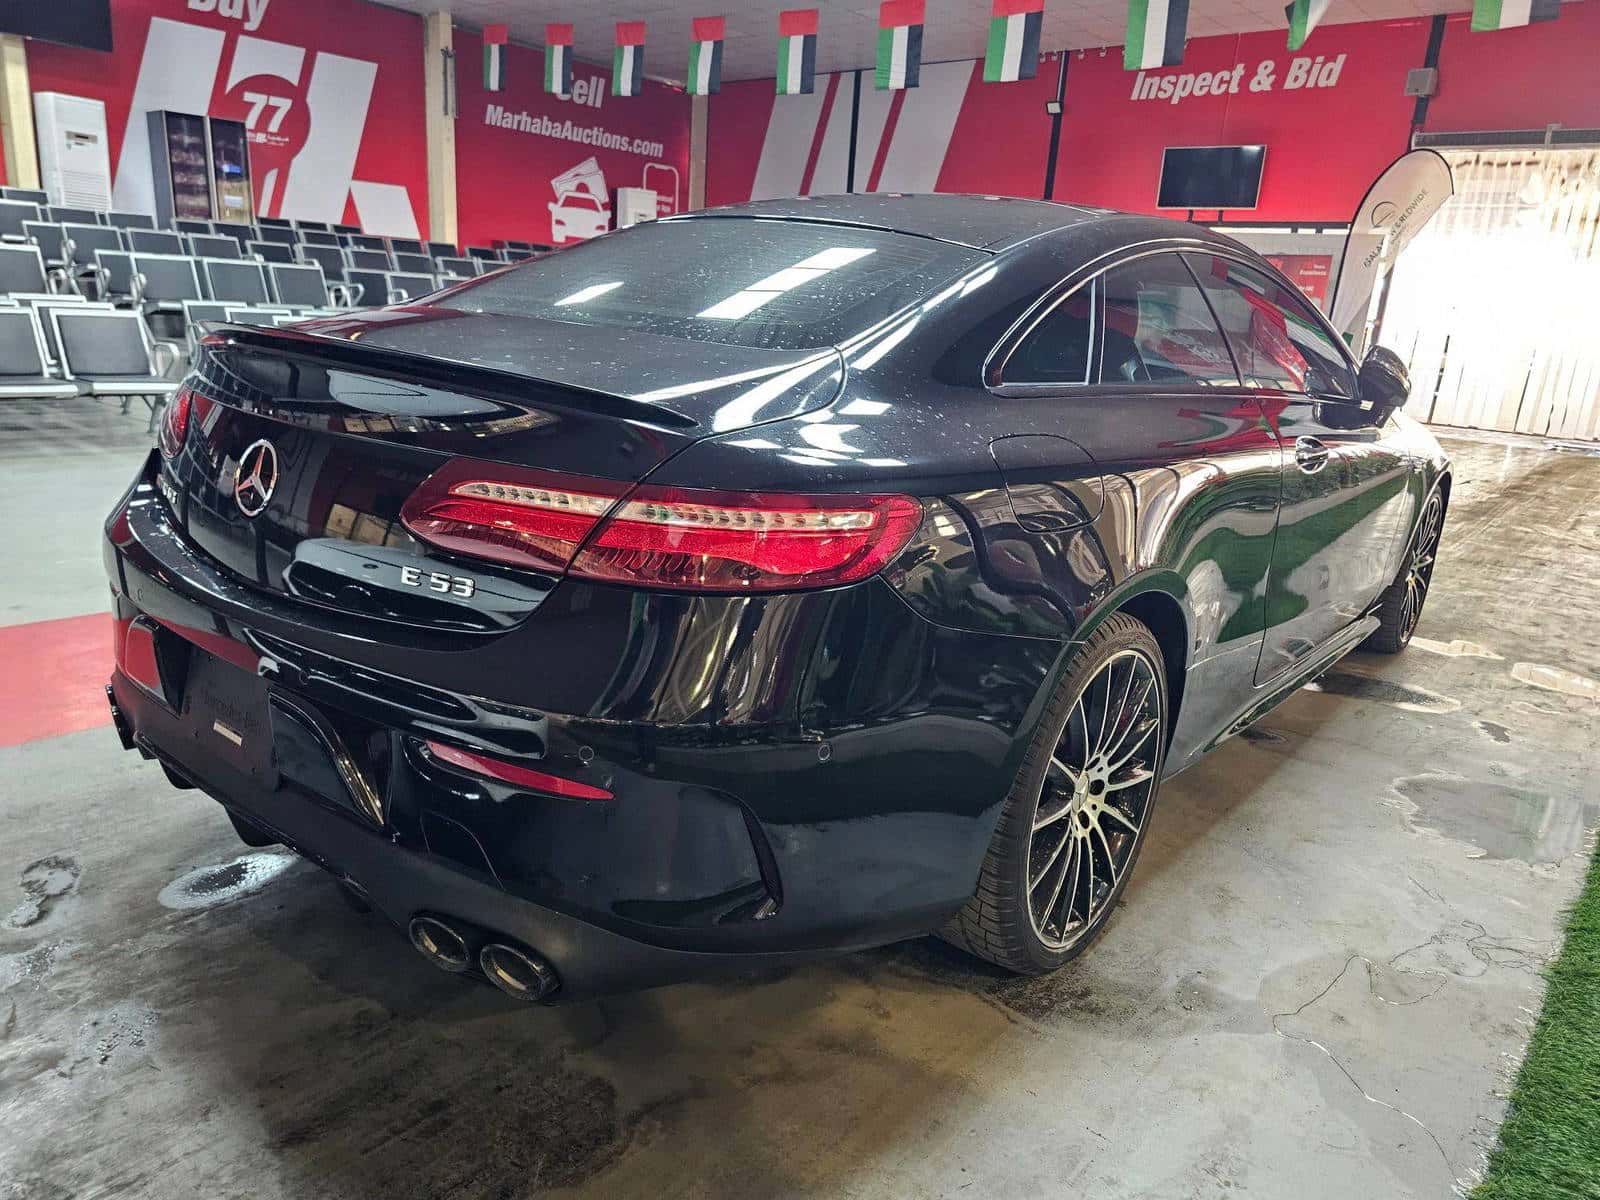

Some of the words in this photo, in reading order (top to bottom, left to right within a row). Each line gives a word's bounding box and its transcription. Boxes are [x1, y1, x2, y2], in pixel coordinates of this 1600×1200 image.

[1130, 63, 1245, 105] Inspect
[1249, 60, 1276, 92] &
[1283, 54, 1347, 90] Bid
[243, 91, 293, 133] 77
[485, 103, 664, 158] MarhabaAuctions.com
[401, 566, 423, 587] E
[430, 572, 475, 598] 53
